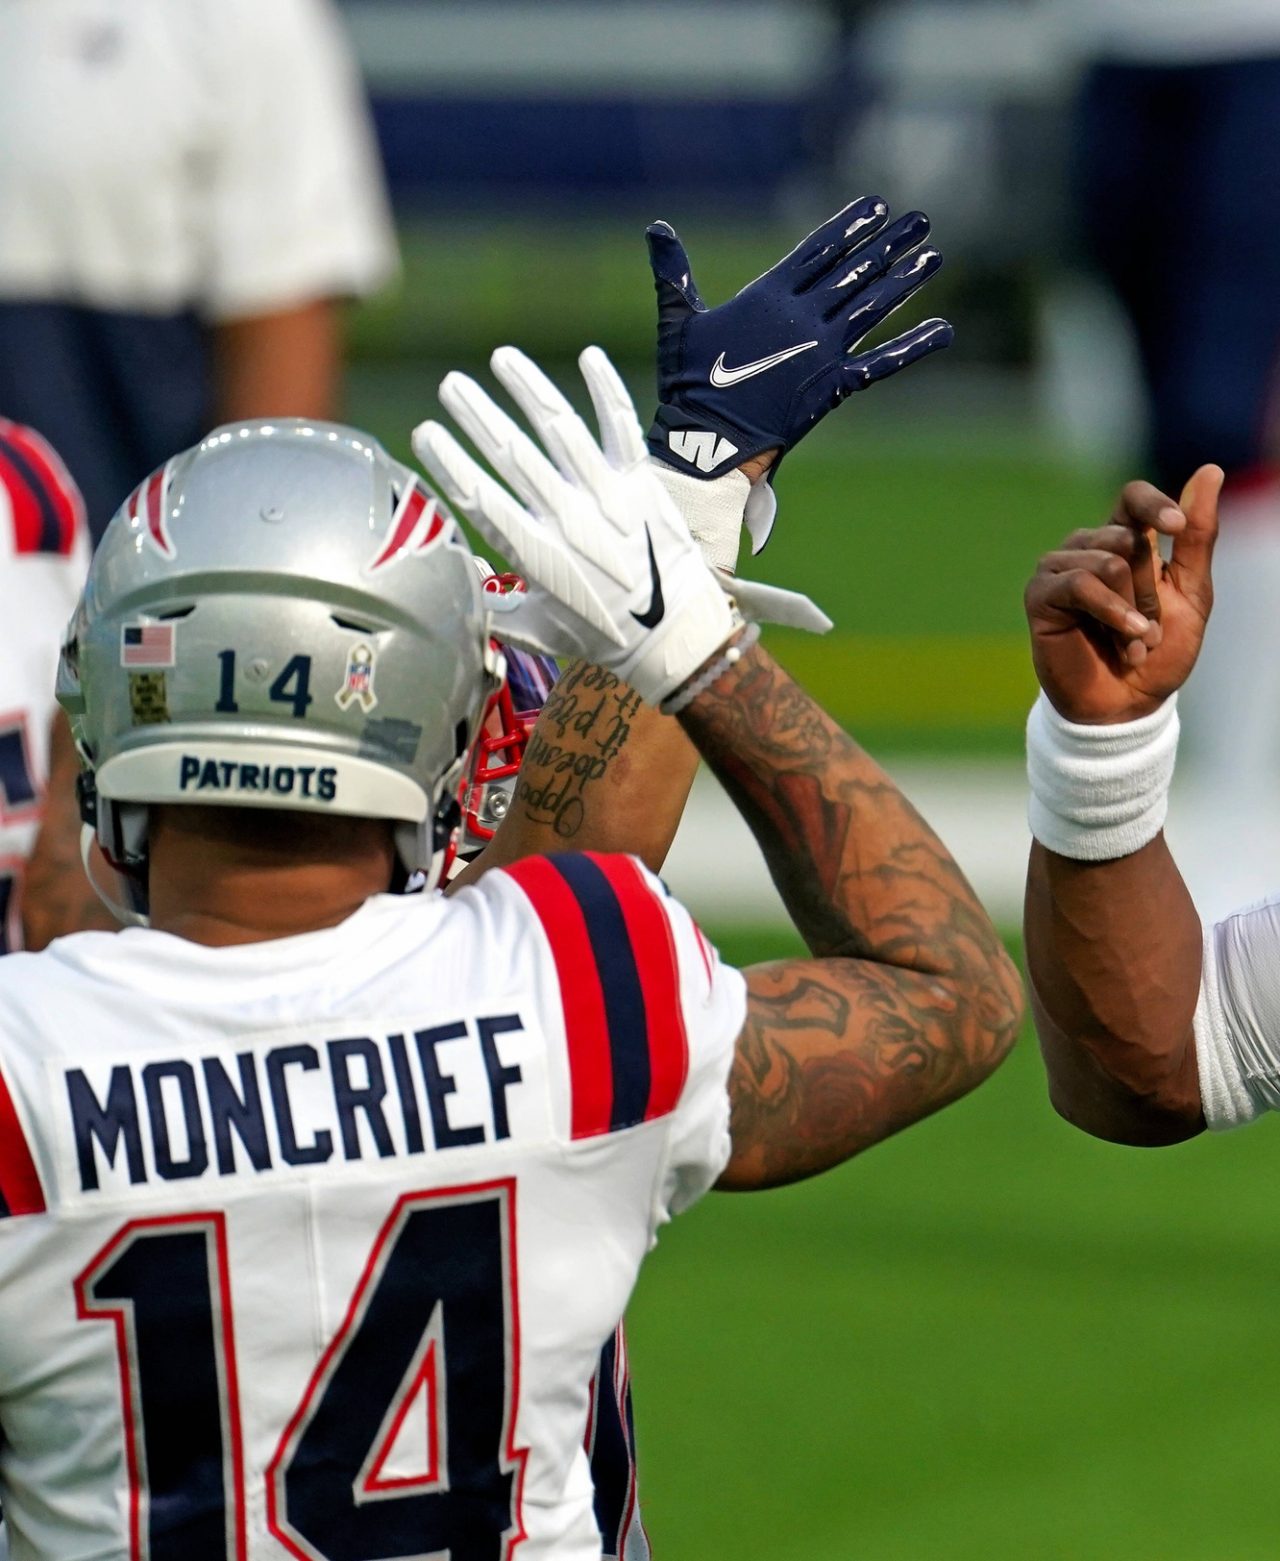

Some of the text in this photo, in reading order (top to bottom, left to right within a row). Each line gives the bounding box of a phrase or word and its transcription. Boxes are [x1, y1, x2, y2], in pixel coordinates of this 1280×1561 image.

[179, 754, 338, 801] PATRIOTS
[64, 1013, 525, 1192] MONCRIEF
[73, 1176, 529, 1561] 14
